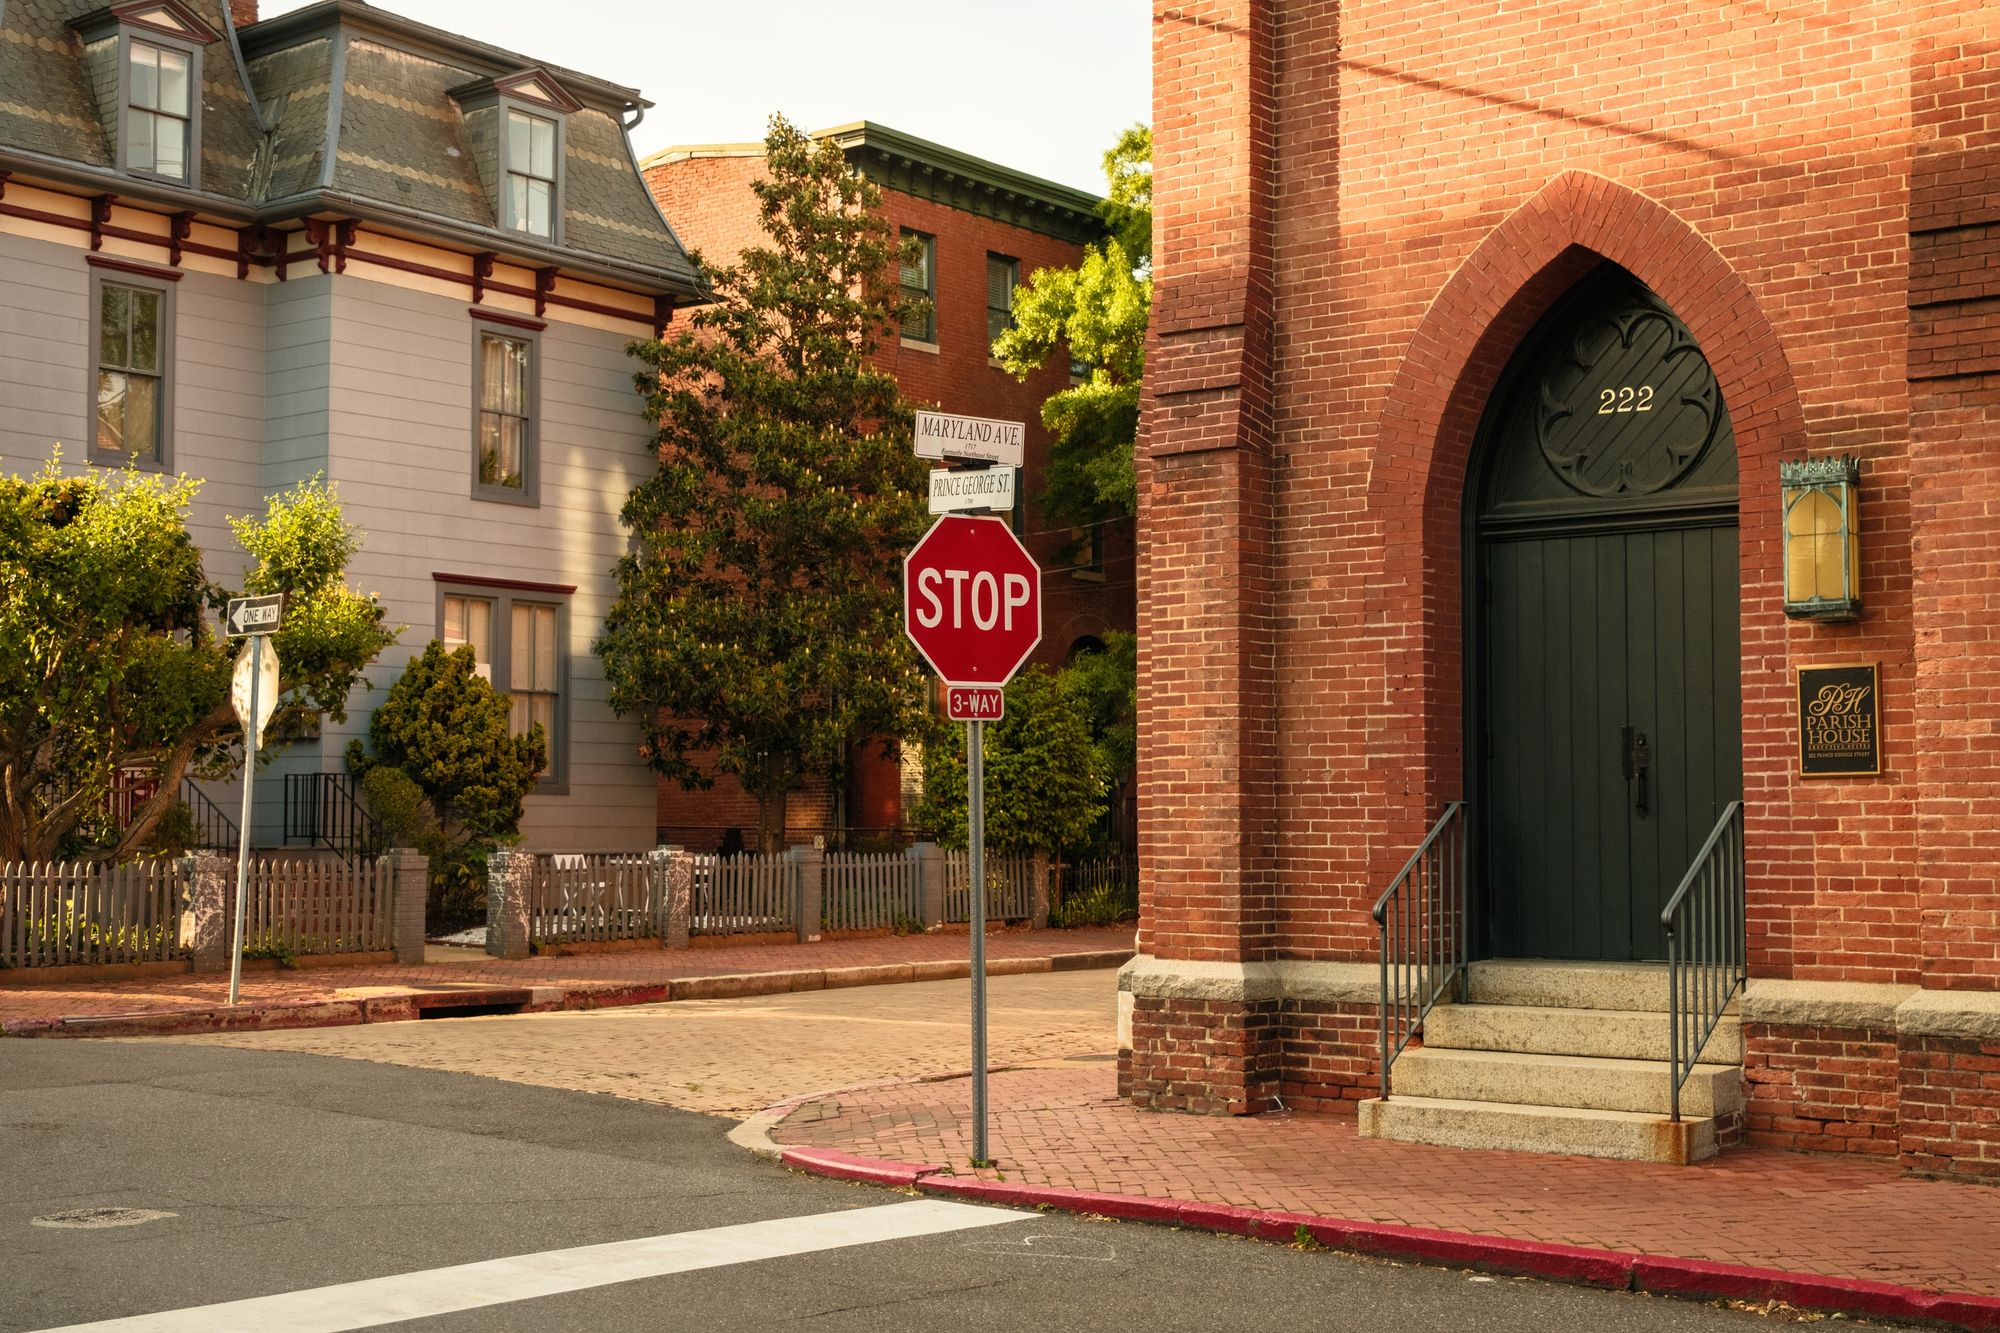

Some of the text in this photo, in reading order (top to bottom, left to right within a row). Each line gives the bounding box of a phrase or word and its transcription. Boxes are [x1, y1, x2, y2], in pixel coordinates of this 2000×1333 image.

[1598, 385, 1654, 414] 222
[921, 417, 1020, 446] MARYLAND AVE.
[933, 473, 1010, 497] PRINCE GEORGE ST.
[916, 567, 1030, 631] STOP
[243, 606, 277, 624] ONE WAY
[953, 693, 999, 713] 3-WAY
[1805, 714, 1872, 730] PARISH
[1808, 728, 1870, 744] HOUSE
